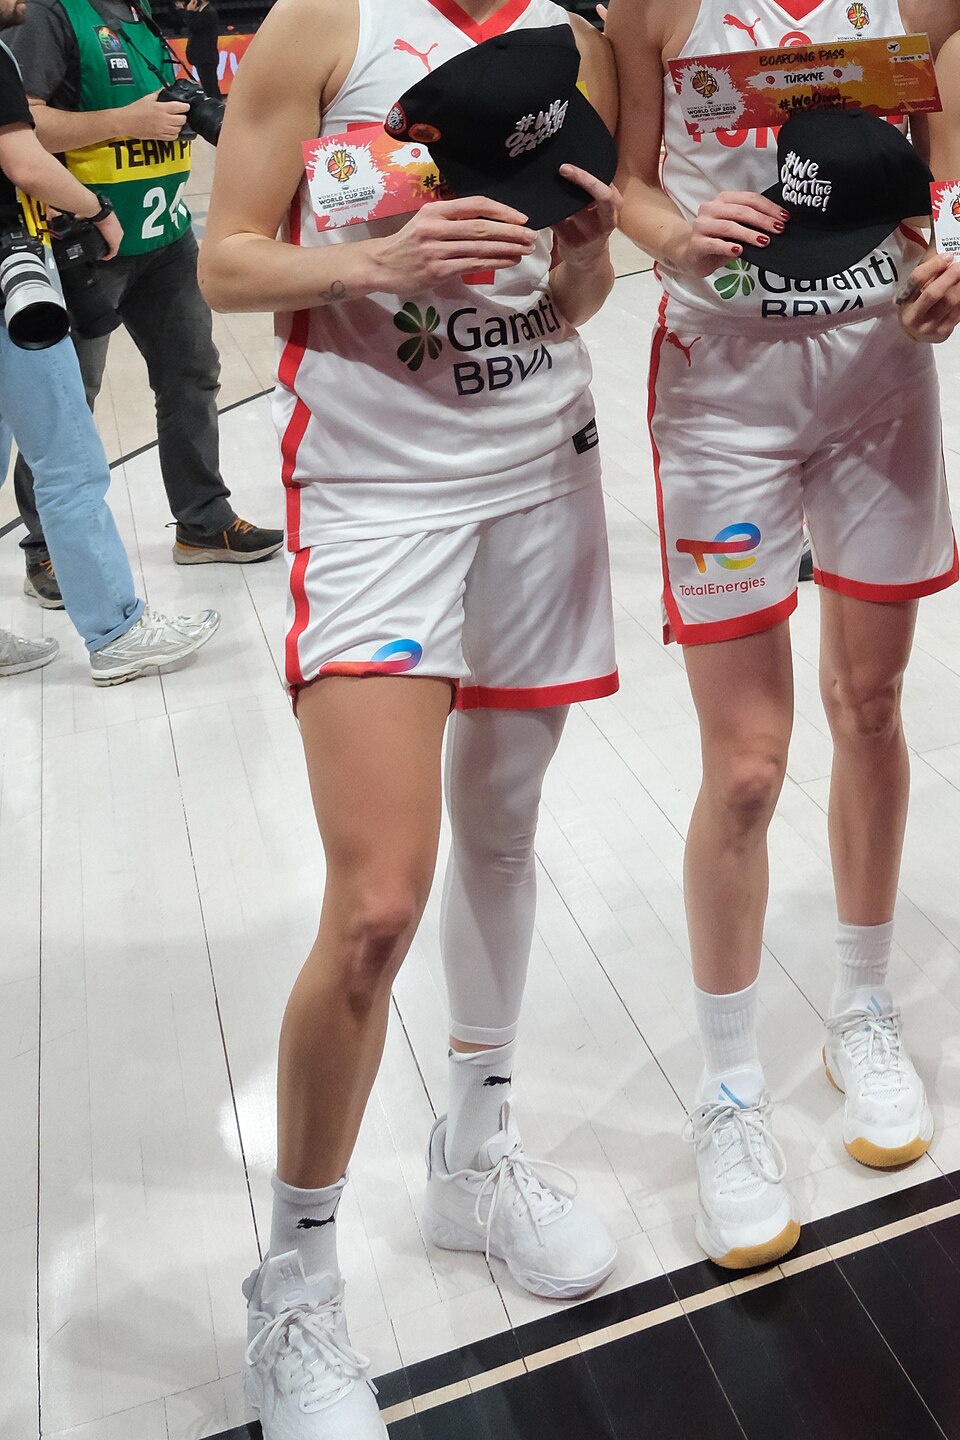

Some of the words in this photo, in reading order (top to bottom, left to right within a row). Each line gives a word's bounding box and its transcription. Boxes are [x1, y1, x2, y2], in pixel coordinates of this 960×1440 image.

[110, 58, 129, 70] FIBA
[759, 50, 815, 67] BOARDING
[818, 48, 845, 61] PASS
[108, 138, 176, 171] TEAM
[784, 150, 819, 179] #We
[318, 195, 344, 205] WORLD
[344, 192, 358, 201] CUP
[359, 189, 376, 198] 2026
[782, 183, 830, 212] Game!
[447, 294, 561, 352] Garanti
[453, 343, 553, 396] BBVA
[679, 576, 766, 597] TotalEnergies
